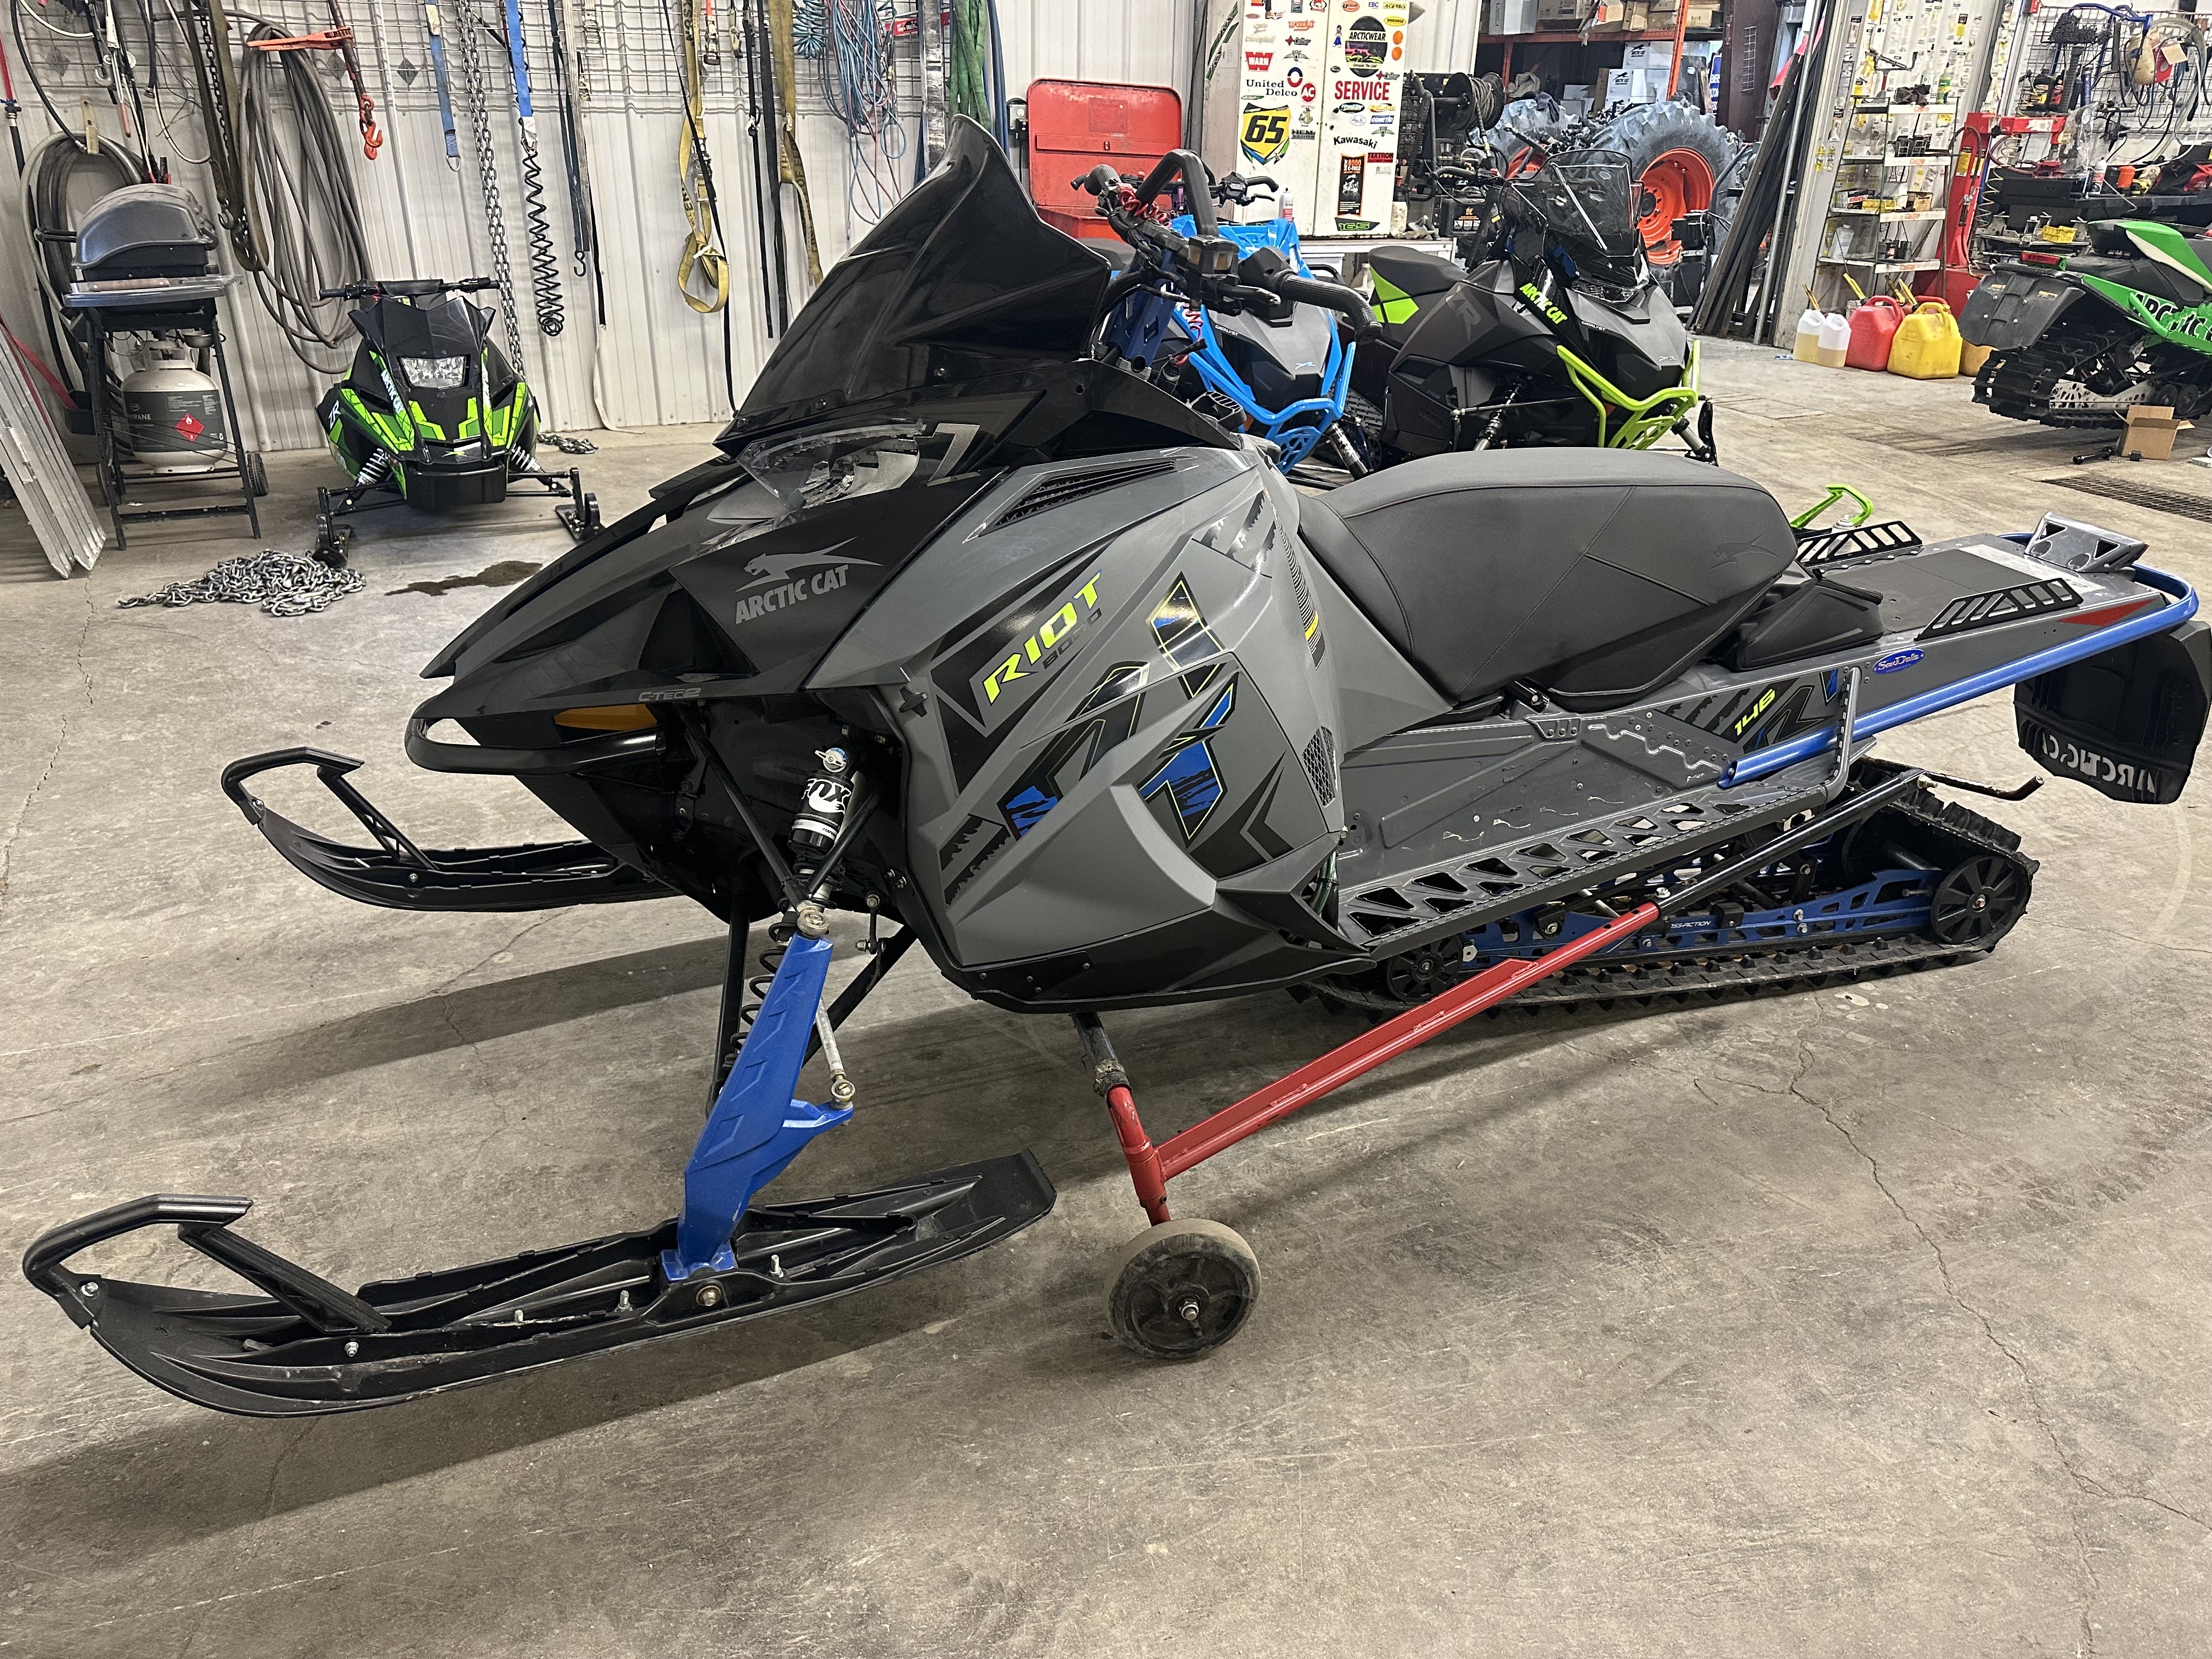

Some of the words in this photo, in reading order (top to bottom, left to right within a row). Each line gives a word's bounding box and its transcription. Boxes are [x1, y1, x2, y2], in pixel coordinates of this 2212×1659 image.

[1349, 31, 1386, 41] ARCTICWEAR
[1248, 57, 1269, 66] WARN
[1245, 79, 1285, 88] United
[1334, 81, 1390, 100] SERVICE
[1265, 88, 1297, 97] Delco
[1301, 87, 1315, 98] AC
[1245, 115, 1288, 144] 65
[1334, 136, 1378, 150] Kawasaki
[1339, 222, 1370, 230] 165
[1519, 283, 1553, 312] ARCTIC
[1546, 307, 1568, 325] CAT
[1215, 324, 1239, 336] CATALYST
[1581, 320, 1606, 331] CATALYST
[329, 400, 341, 430] ZR
[736, 578, 807, 625] ARCTIC
[811, 564, 849, 595] CAT
[982, 569, 1102, 707] RIOT
[638, 687, 702, 702] C-TEC2
[1734, 688, 1776, 737] 146
